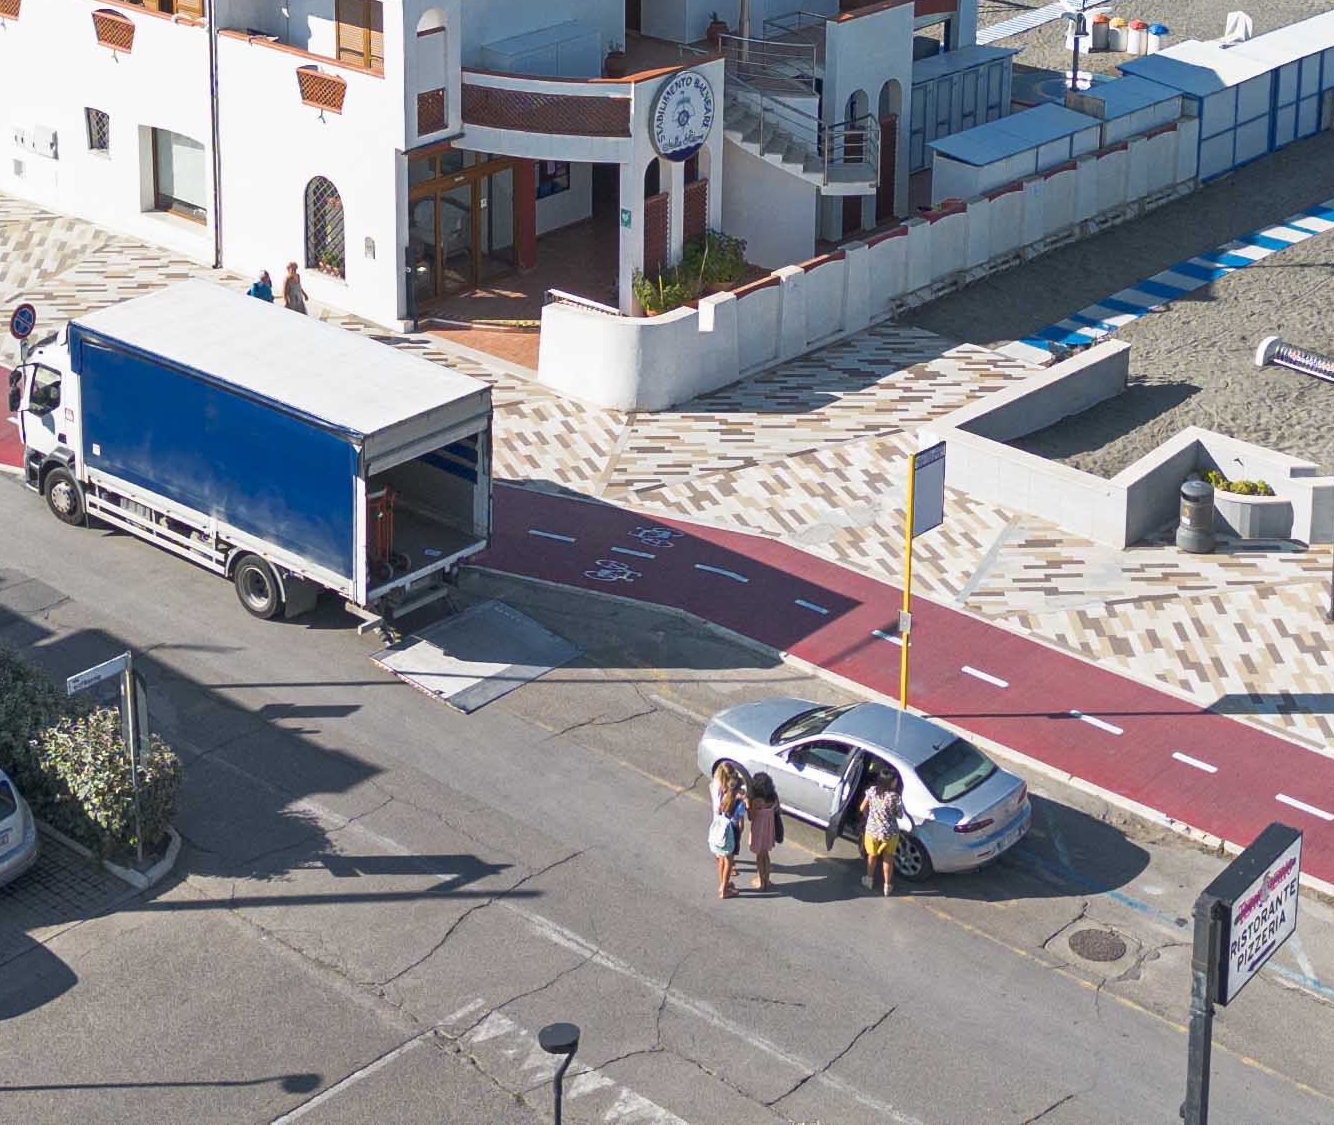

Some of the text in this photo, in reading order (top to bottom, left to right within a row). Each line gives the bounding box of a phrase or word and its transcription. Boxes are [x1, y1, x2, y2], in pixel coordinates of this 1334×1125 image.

[656, 77, 712, 144] STABILIMENTO BALNEARE
[1230, 877, 1297, 960] RISTORANTE
[1237, 909, 1286, 972] PIZZERIA
